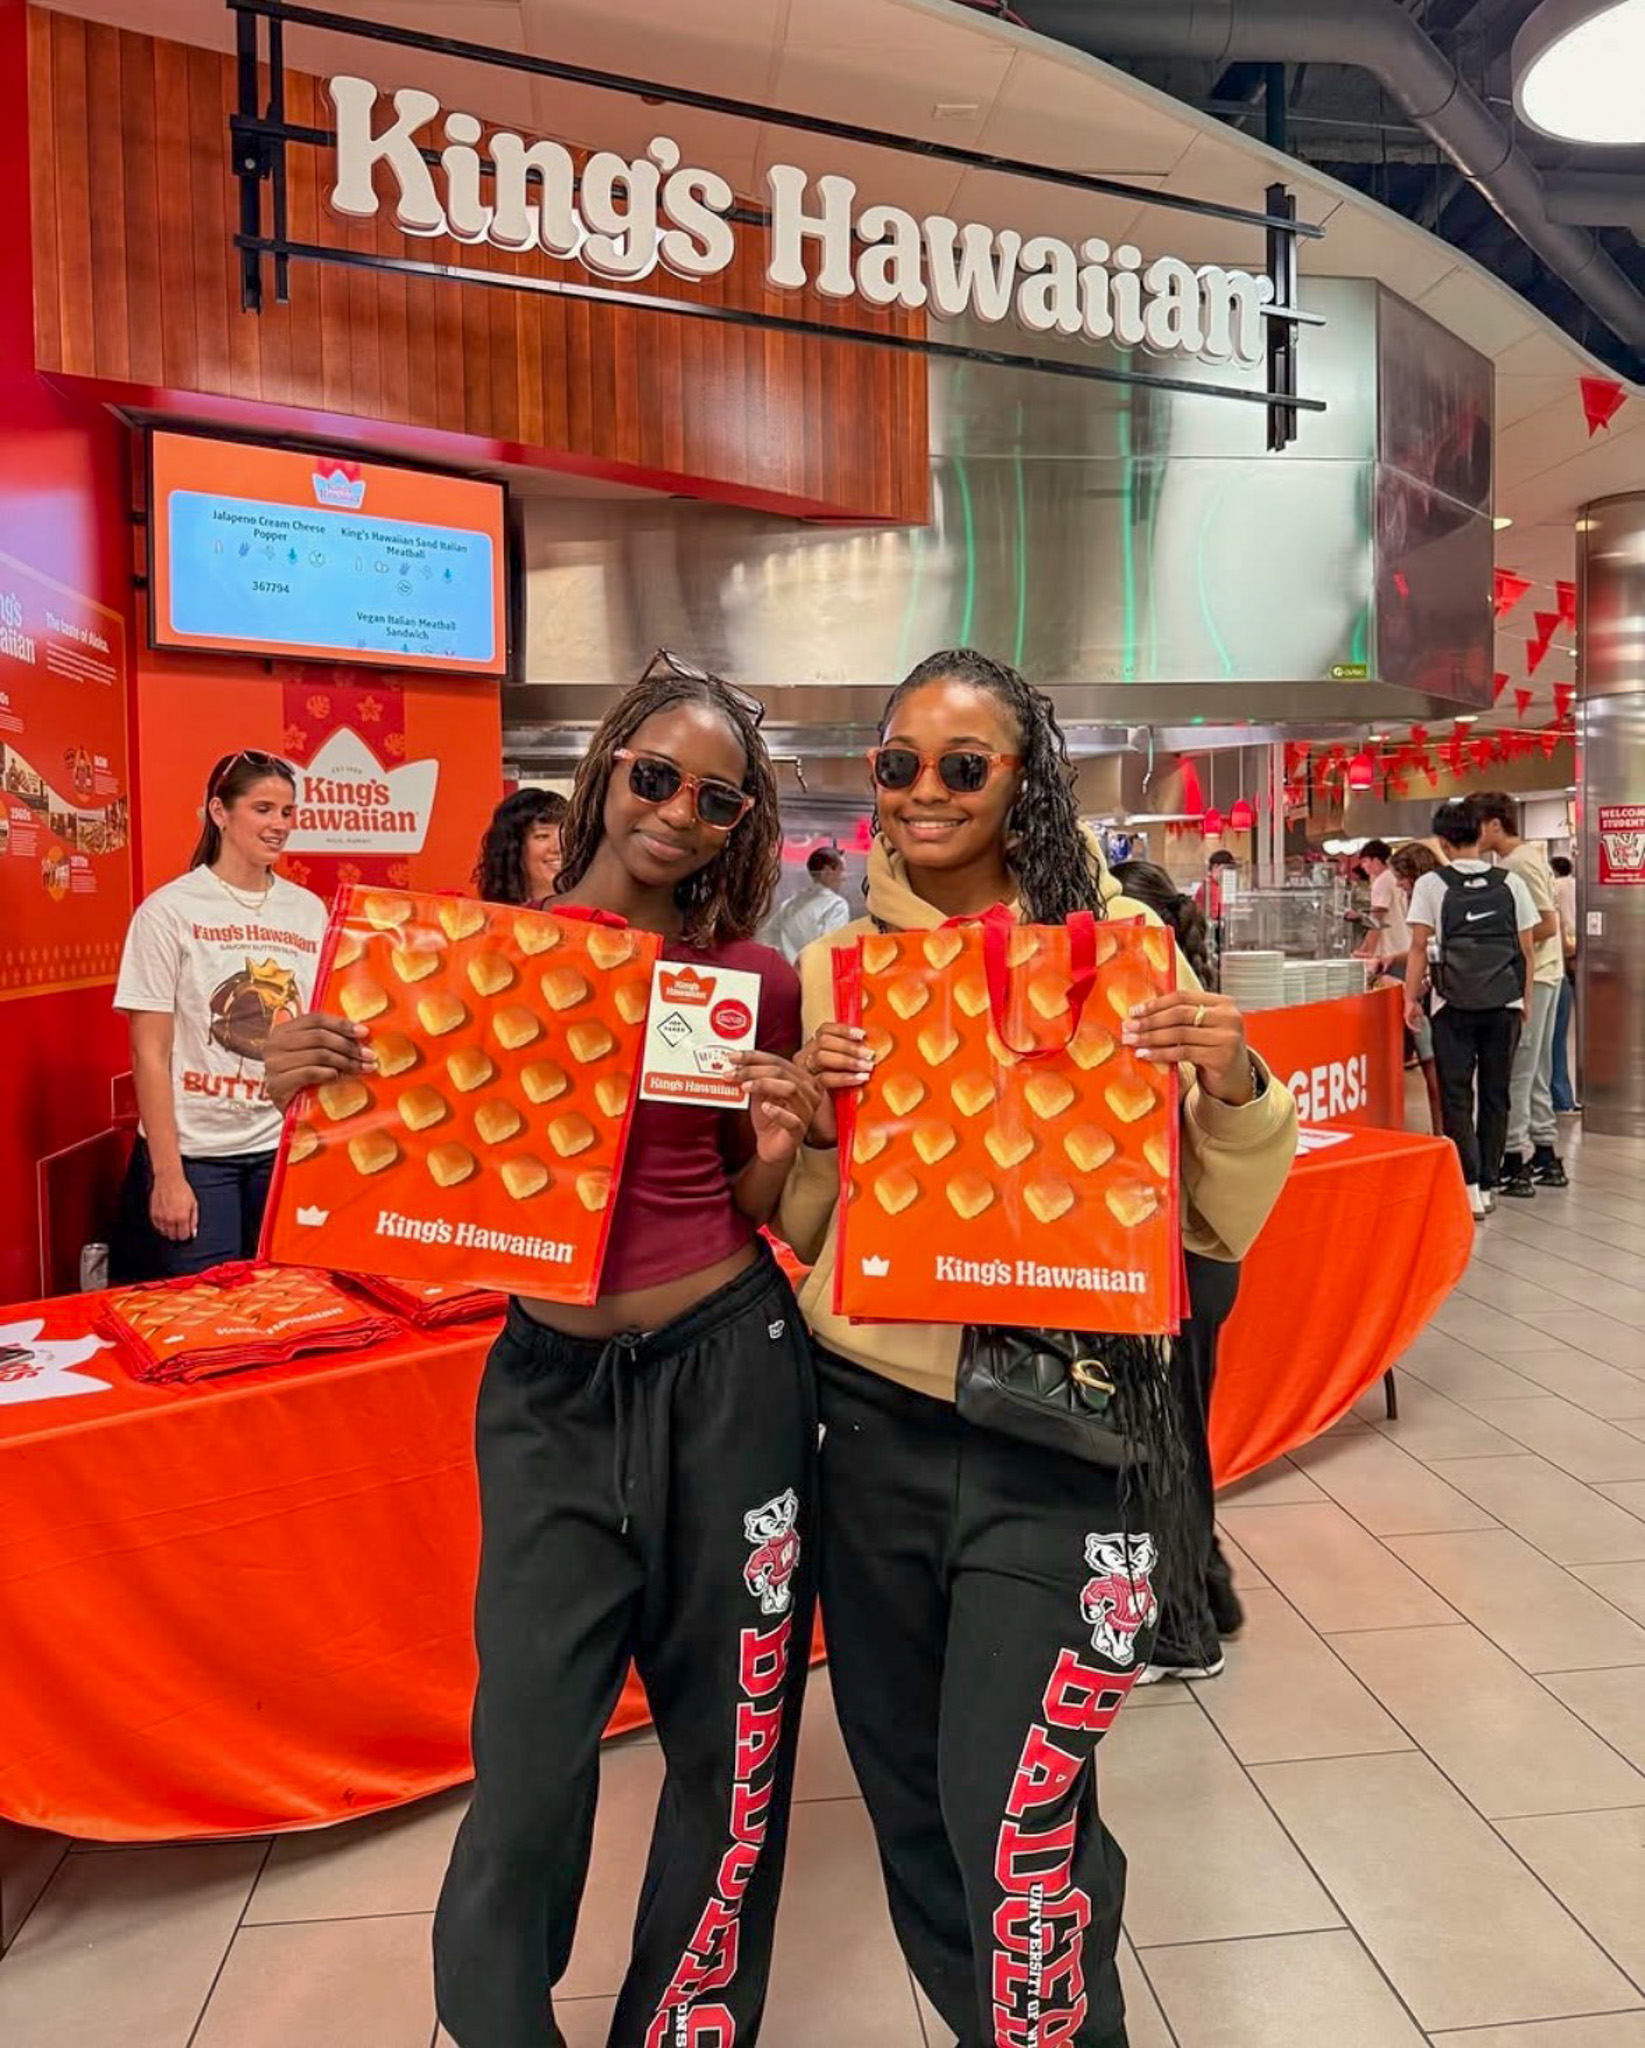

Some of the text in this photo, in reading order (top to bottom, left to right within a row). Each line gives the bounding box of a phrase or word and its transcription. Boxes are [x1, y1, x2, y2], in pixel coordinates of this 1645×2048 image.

[328, 75, 1273, 367] King's Hawaiian
[213, 509, 326, 534] Jalapeno Cream Cheese
[253, 527, 287, 541] Popper
[341, 527, 468, 553] King's Hawaiian Sand Italian
[386, 545, 425, 559] Meatball
[252, 581, 290, 593] 367794
[356, 611, 456, 631] Vegan Italian Meatball
[386, 626, 430, 640] Sandwich
[303, 776, 391, 807] King's
[375, 1210, 574, 1264] King's Hawaiian
[935, 1255, 1147, 1293] King's Hawaiian
[993, 1647, 1147, 2048] BADGER
[1028, 1883, 1043, 1997] UNIVERSITY
[1027, 1999, 1040, 2020] OF
